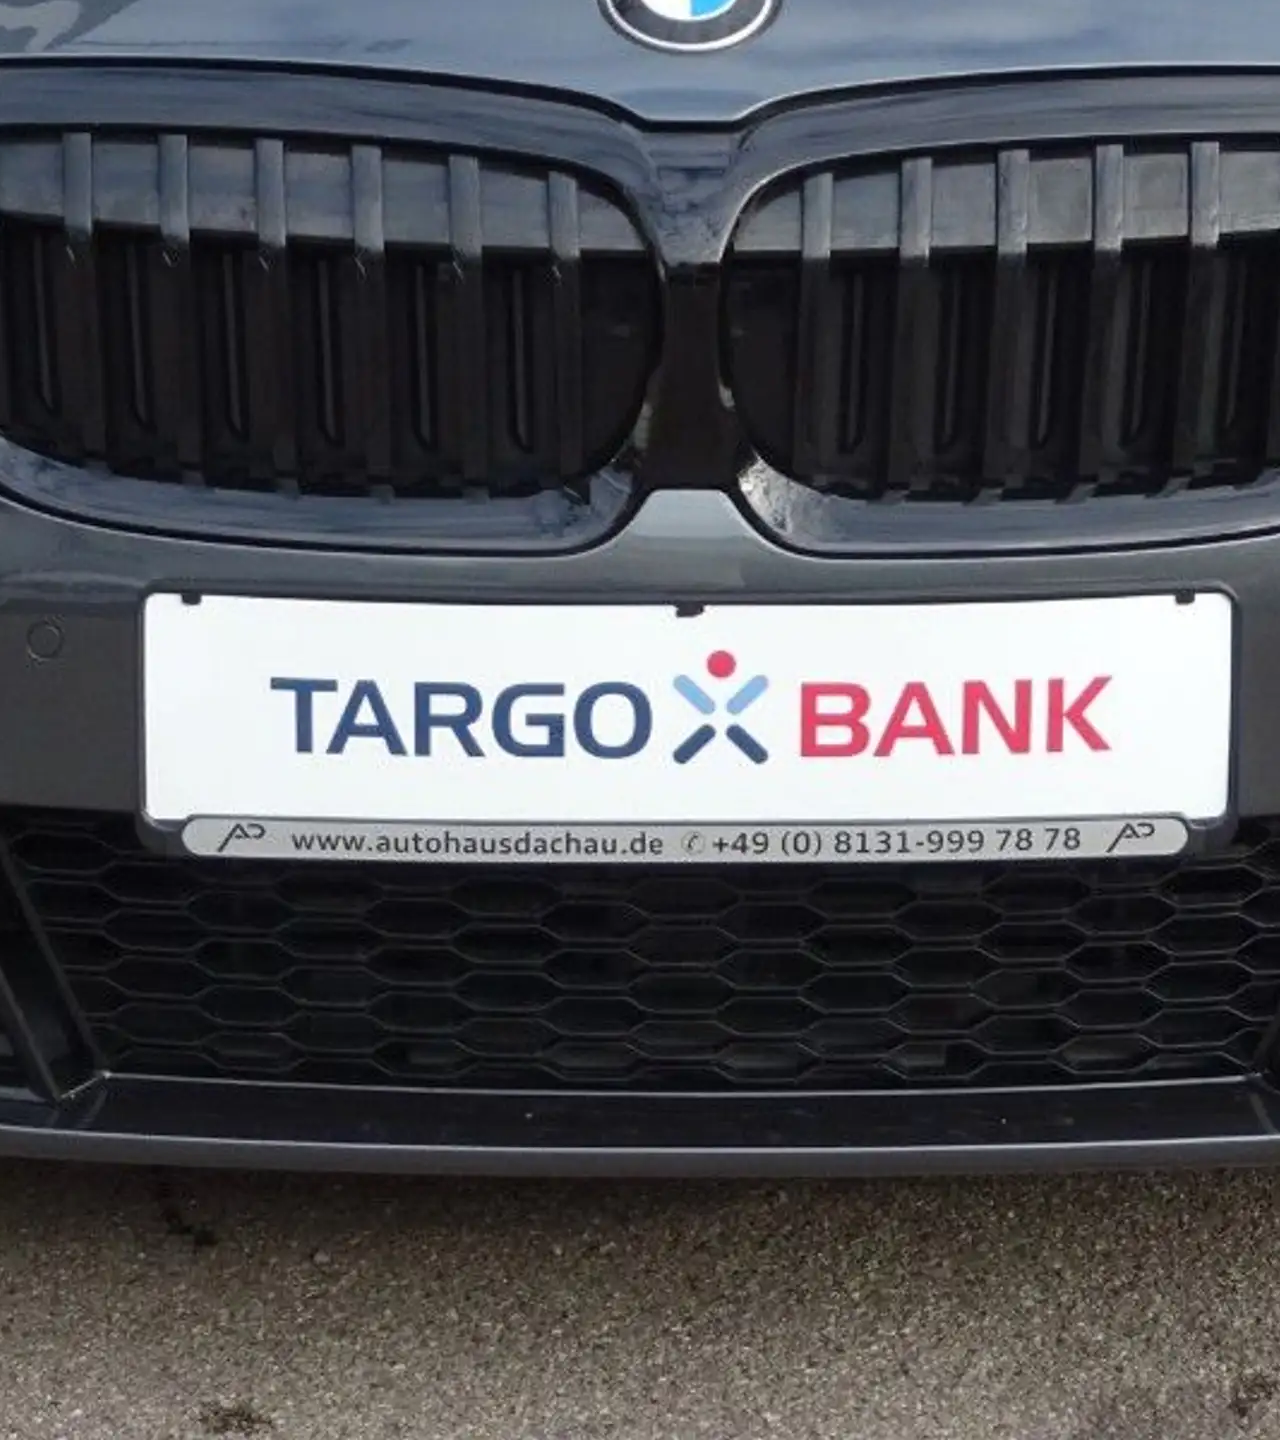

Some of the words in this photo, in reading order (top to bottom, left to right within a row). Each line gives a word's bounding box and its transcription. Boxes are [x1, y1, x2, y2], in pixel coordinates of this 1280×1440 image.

[269, 675, 653, 759] TARGO
[799, 674, 1115, 758] BANK
[291, 830, 664, 857] www.autohausdachau.de
[711, 830, 770, 855] +49
[780, 830, 822, 858] (0)
[833, 828, 985, 855] 8131-999
[995, 827, 1034, 851] 78
[1044, 826, 1082, 850] 78
